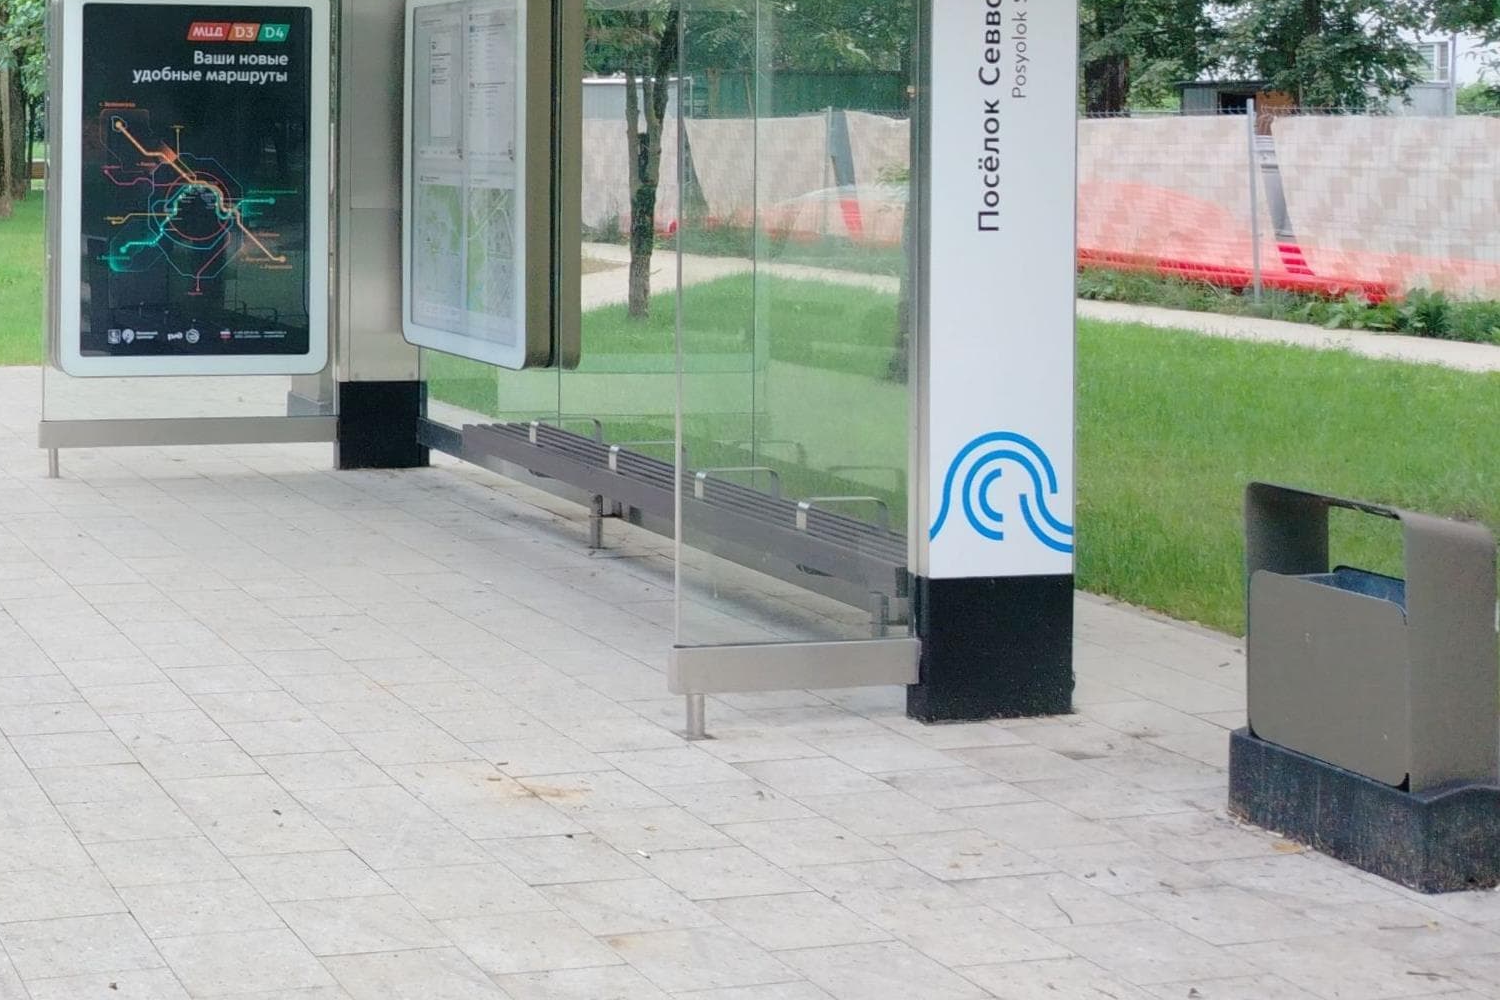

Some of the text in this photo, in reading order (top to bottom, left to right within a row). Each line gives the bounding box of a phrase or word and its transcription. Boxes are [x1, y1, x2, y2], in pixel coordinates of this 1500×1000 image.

[192, 26, 285, 39] МЦД D3 D4
[193, 50, 289, 66] Ваши новые
[1011, 11, 1031, 99] Posyolok
[132, 66, 288, 85] удобные маршруты
[977, 98, 1001, 232] Посёлок
